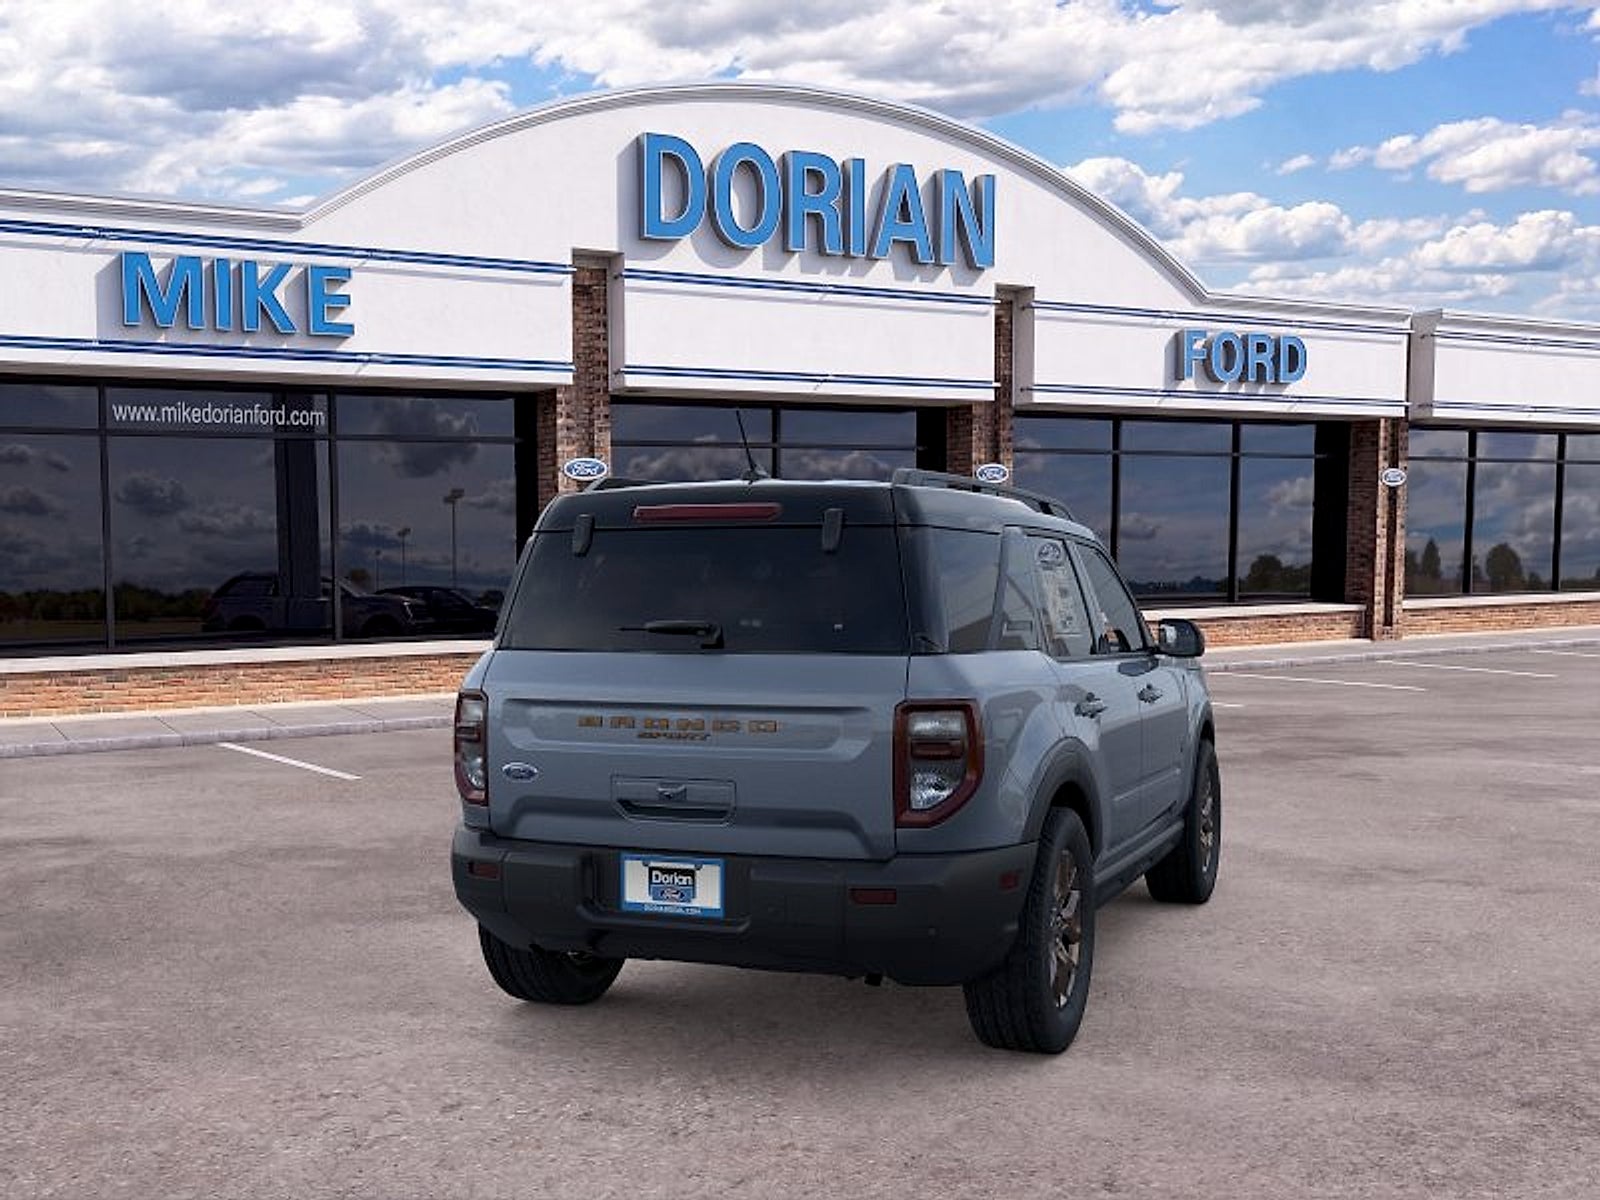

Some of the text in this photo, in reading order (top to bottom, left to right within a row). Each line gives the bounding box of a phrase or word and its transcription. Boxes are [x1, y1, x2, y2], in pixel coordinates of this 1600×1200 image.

[639, 132, 995, 269] DORIAN
[121, 251, 355, 338] MIKE
[1176, 328, 1307, 384] FORD
[112, 402, 326, 426] www.mikedorianford.com
[651, 870, 694, 885] Dorian
